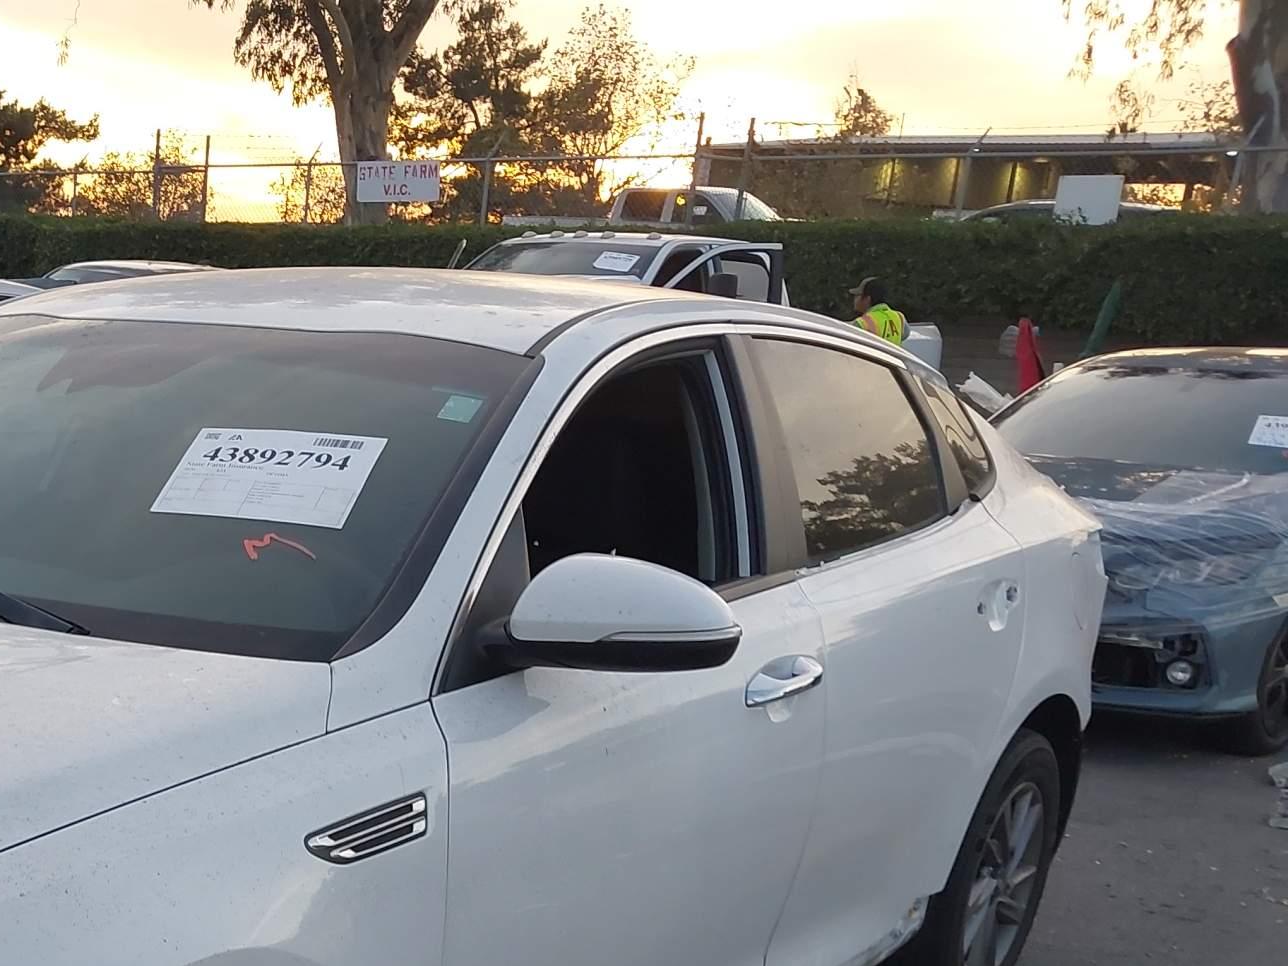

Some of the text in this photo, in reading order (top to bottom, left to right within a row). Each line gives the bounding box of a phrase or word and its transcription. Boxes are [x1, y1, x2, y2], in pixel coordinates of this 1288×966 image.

[359, 163, 438, 181] STATE FARM
[383, 183, 412, 196] V.I.C.
[202, 446, 352, 471] 43892794
